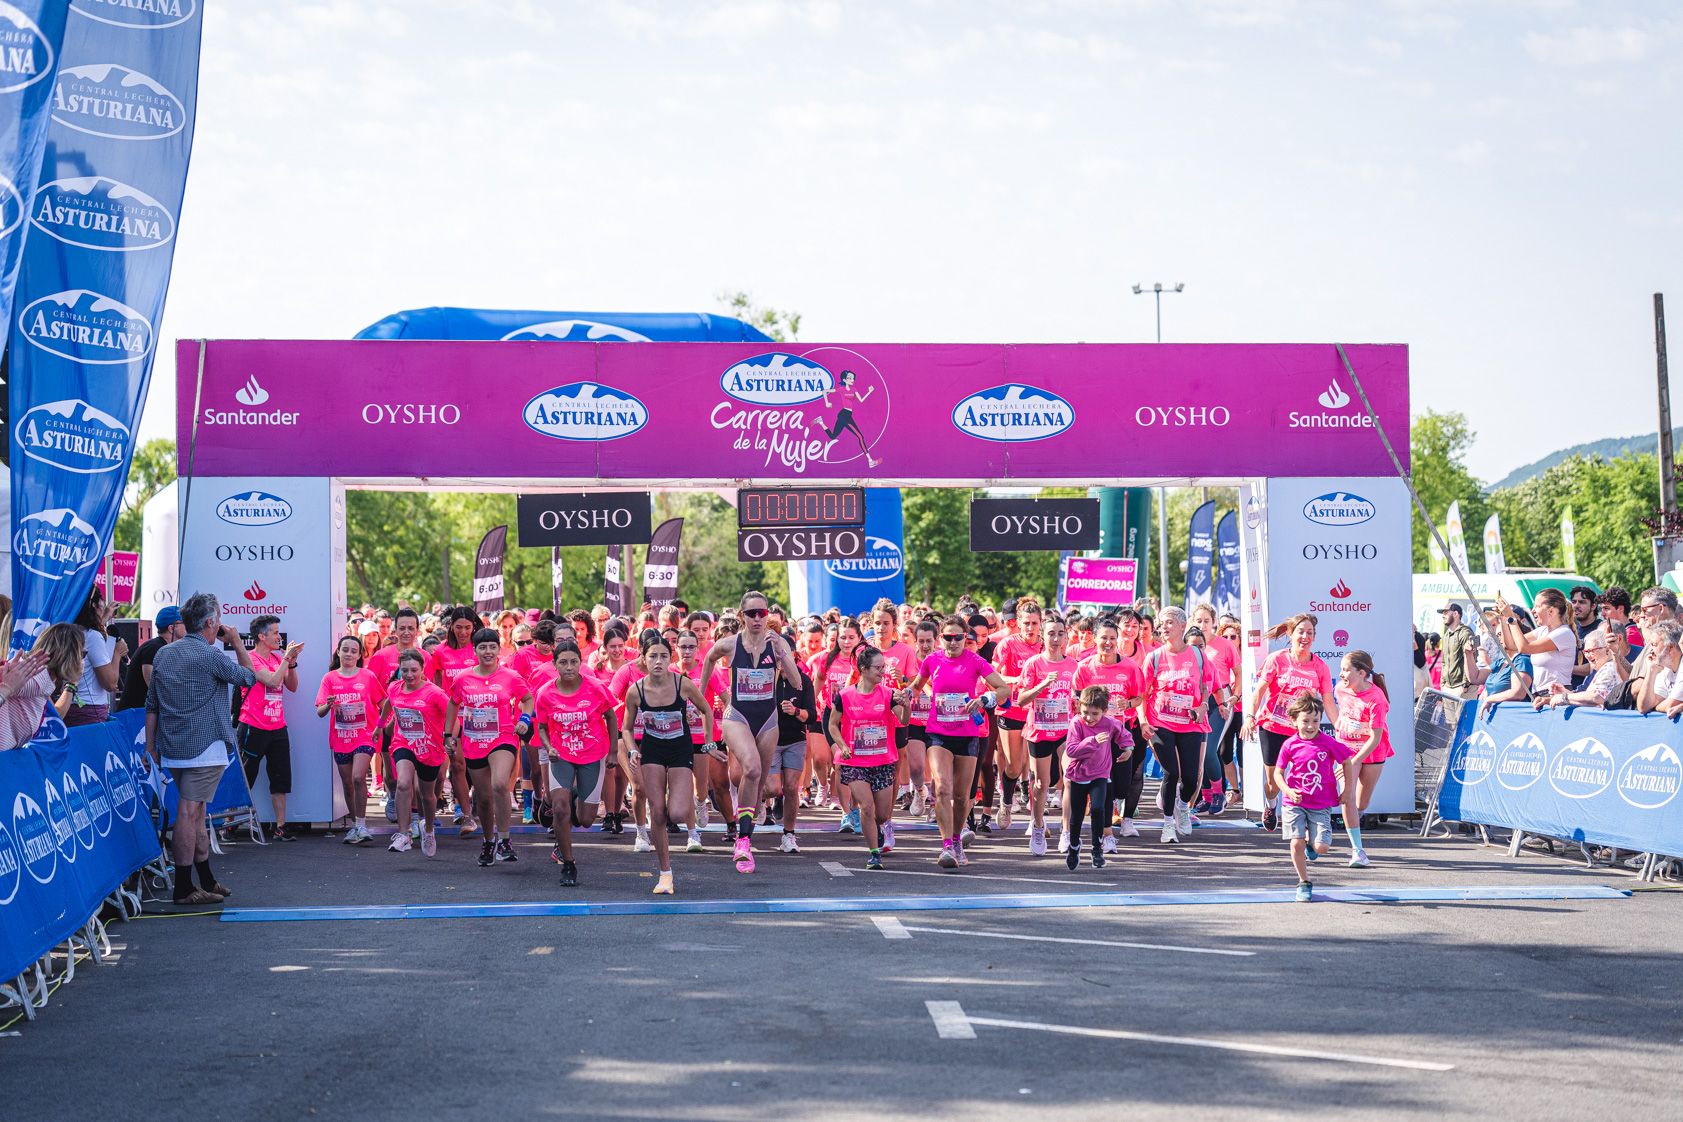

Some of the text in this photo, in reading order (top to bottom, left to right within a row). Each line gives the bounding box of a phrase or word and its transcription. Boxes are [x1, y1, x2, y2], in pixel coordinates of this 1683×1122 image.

[53, 82, 175, 129] ASTURIANA
[71, 83, 171, 107] CENTRAL LECHERA
[57, 195, 160, 218] CENTRAL LECHERA
[36, 195, 161, 240] ASTURIANA
[29, 309, 144, 353] ASTURIANA
[53, 310, 143, 331] CENTRAL LECHERA
[729, 371, 826, 392] ASTURIANA
[204, 408, 300, 426] Santander
[362, 403, 461, 425] OYSHO
[533, 403, 639, 426] ASTURIANA
[710, 401, 804, 430] Carrera
[962, 405, 1066, 427] ASTURIANA
[1135, 406, 1230, 426] OYSHO
[25, 418, 122, 461] ASTURIANA
[733, 427, 839, 473] de la Mujer
[222, 504, 287, 518] ASTURIANA
[539, 508, 632, 531] OYSHO
[1308, 504, 1370, 518] ASTURIANA
[991, 514, 1082, 535] OYSHO
[215, 544, 294, 562] OYSHO
[651, 545, 677, 553] OYSHO
[743, 531, 860, 558] OYSHO
[1302, 543, 1378, 561] OYSHO
[479, 556, 501, 566] OYSH
[831, 557, 900, 571] ASTURIANA
[1107, 565, 1134, 573] OYSHO
[1067, 578, 1134, 591] CORREDORAS
[1421, 583, 1488, 594] AMBULACIA
[222, 603, 288, 615] Santander
[1309, 601, 1372, 612] Santander
[1313, 650, 1344, 660] ctopus
[553, 711, 588, 723] CARRERA
[1499, 752, 1541, 777] ASTURIANA
[1552, 756, 1608, 785] ASTURIANA
[1620, 764, 1676, 794] ASTURIANA
